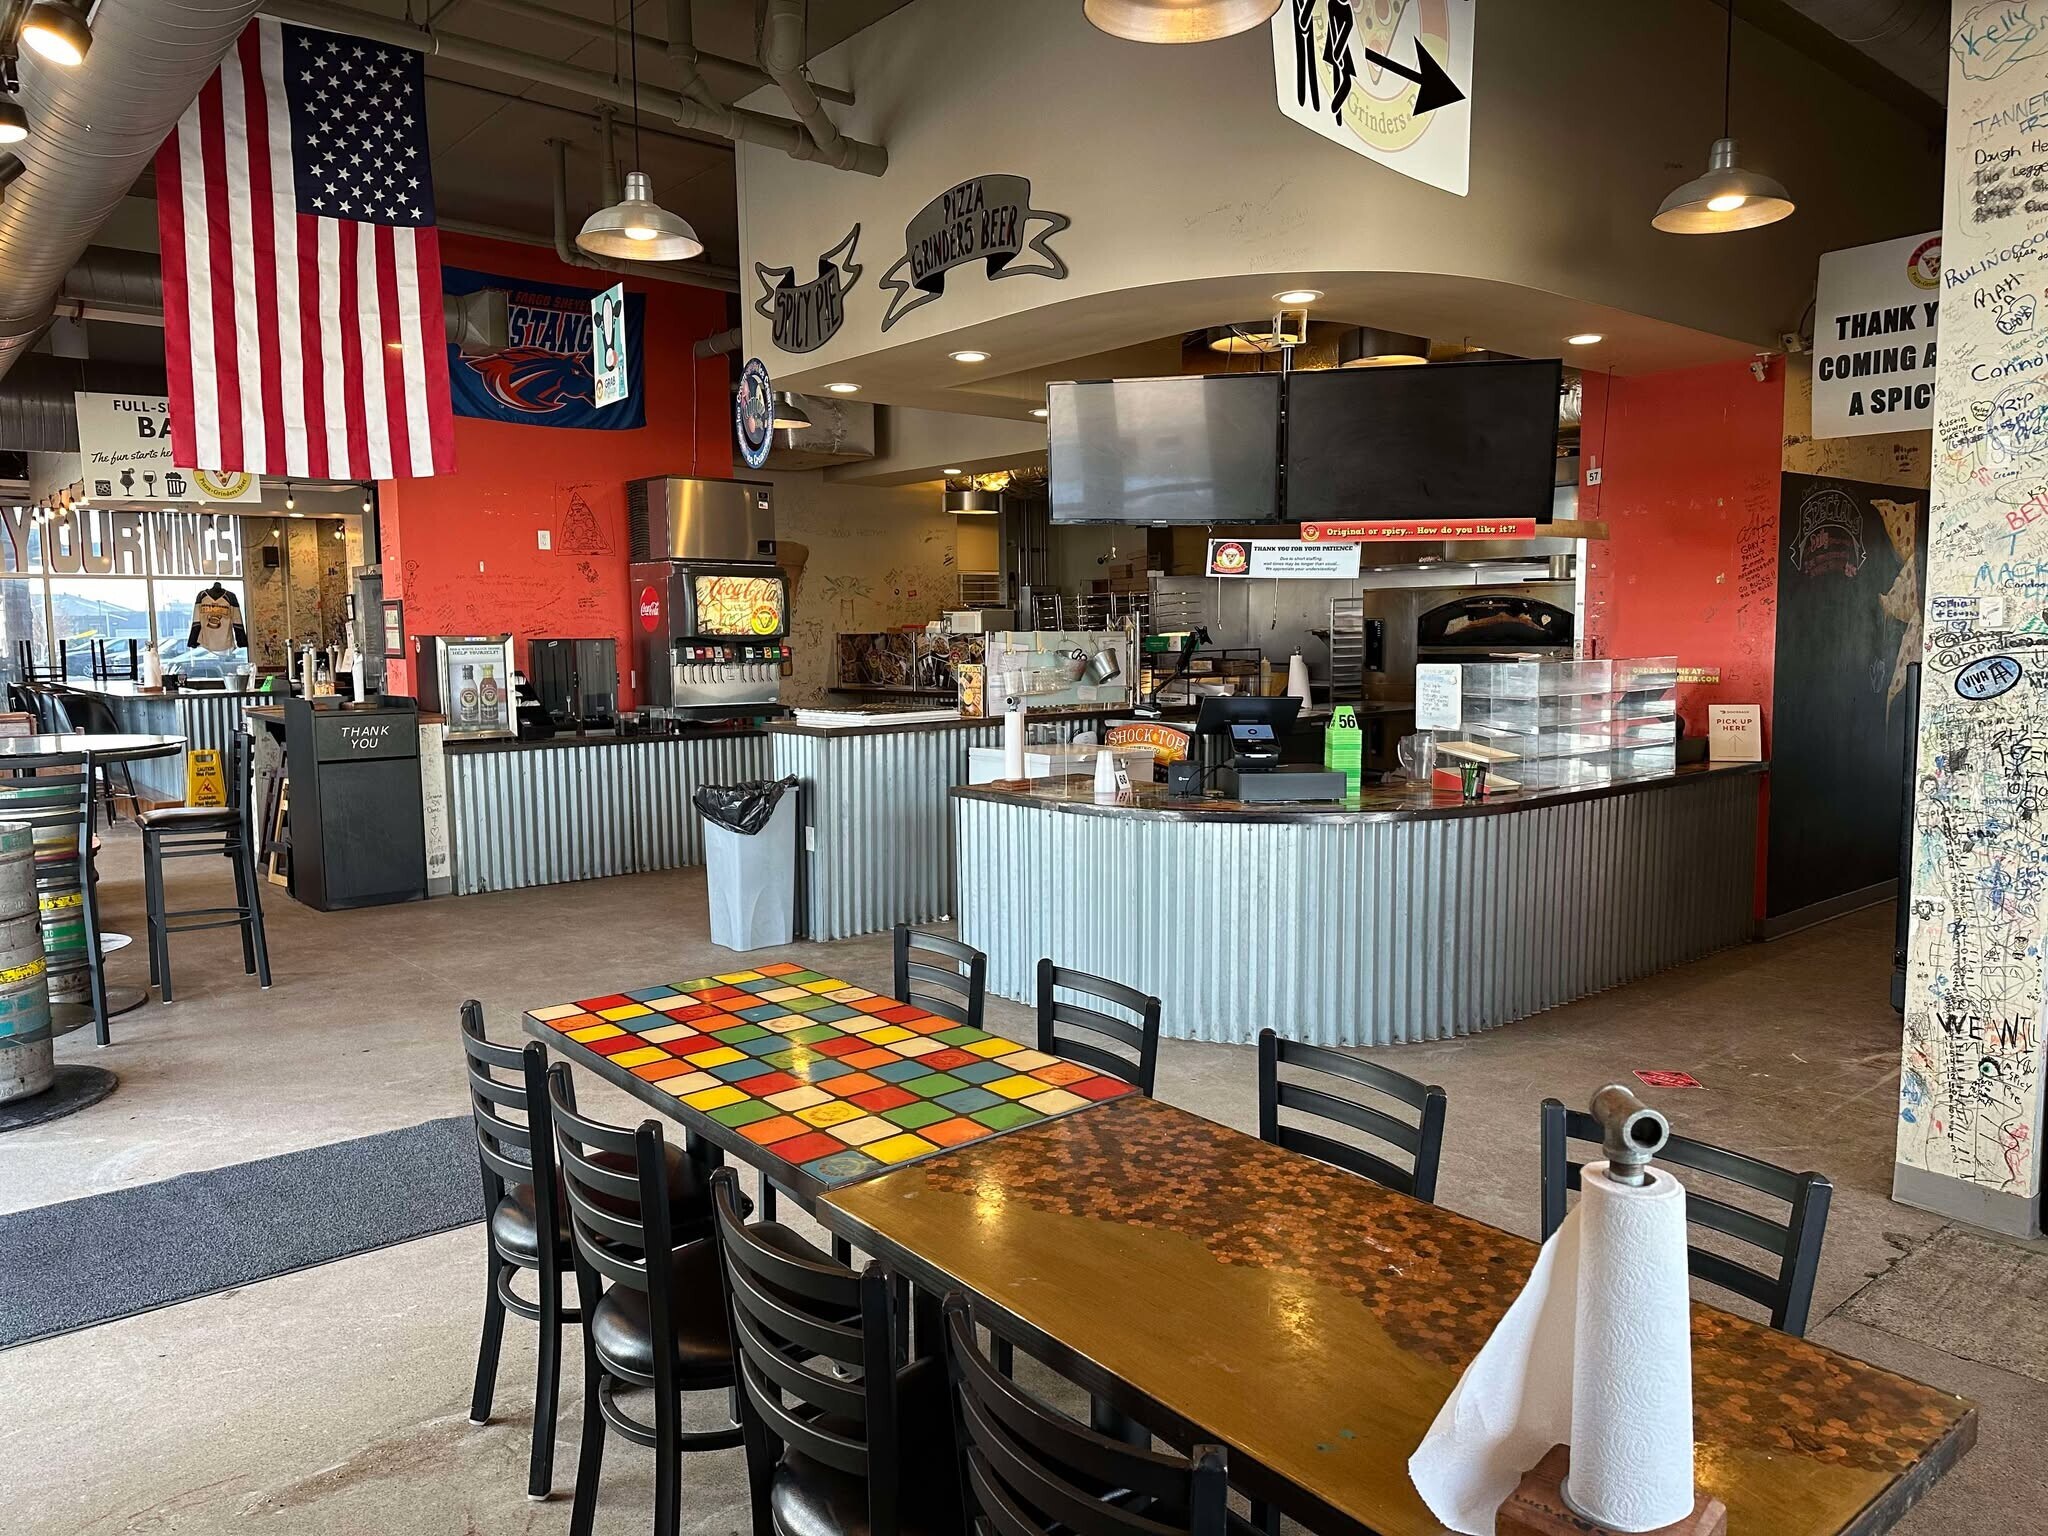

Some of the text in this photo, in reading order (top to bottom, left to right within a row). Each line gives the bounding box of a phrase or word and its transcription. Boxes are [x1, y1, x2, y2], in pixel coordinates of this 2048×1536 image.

[1347, 92, 1407, 134] Grinders
[943, 180, 984, 225] PIZZA
[911, 205, 1018, 279] GRINDERS BEER
[775, 273, 840, 349] SPICY PIE
[508, 305, 593, 354] STANG
[1835, 304, 1917, 341] THANK
[1818, 345, 1917, 382] COMING
[113, 399, 170, 414] FULL-S
[1848, 391, 1864, 417] A
[91, 452, 109, 464] The
[110, 451, 130, 465] fun
[131, 450, 158, 461] starts
[1589, 471, 1599, 482] 57
[1326, 528, 1365, 537] Original
[1381, 527, 1414, 537] spicy...
[1417, 526, 1437, 535] How
[1440, 526, 1452, 534] do
[1455, 526, 1473, 536] you
[1476, 525, 1495, 534] like
[152, 511, 242, 577] WINGS!
[1690, 667, 1705, 675] AT:
[1962, 670, 1989, 688] VIVA
[1974, 682, 1986, 694] LA
[341, 726, 390, 738] THANK
[1338, 714, 1356, 729] 56
[351, 739, 379, 749] YOU
[1108, 728, 1186, 750] SHOCK TOP
[1936, 1012, 1984, 1041] WE
